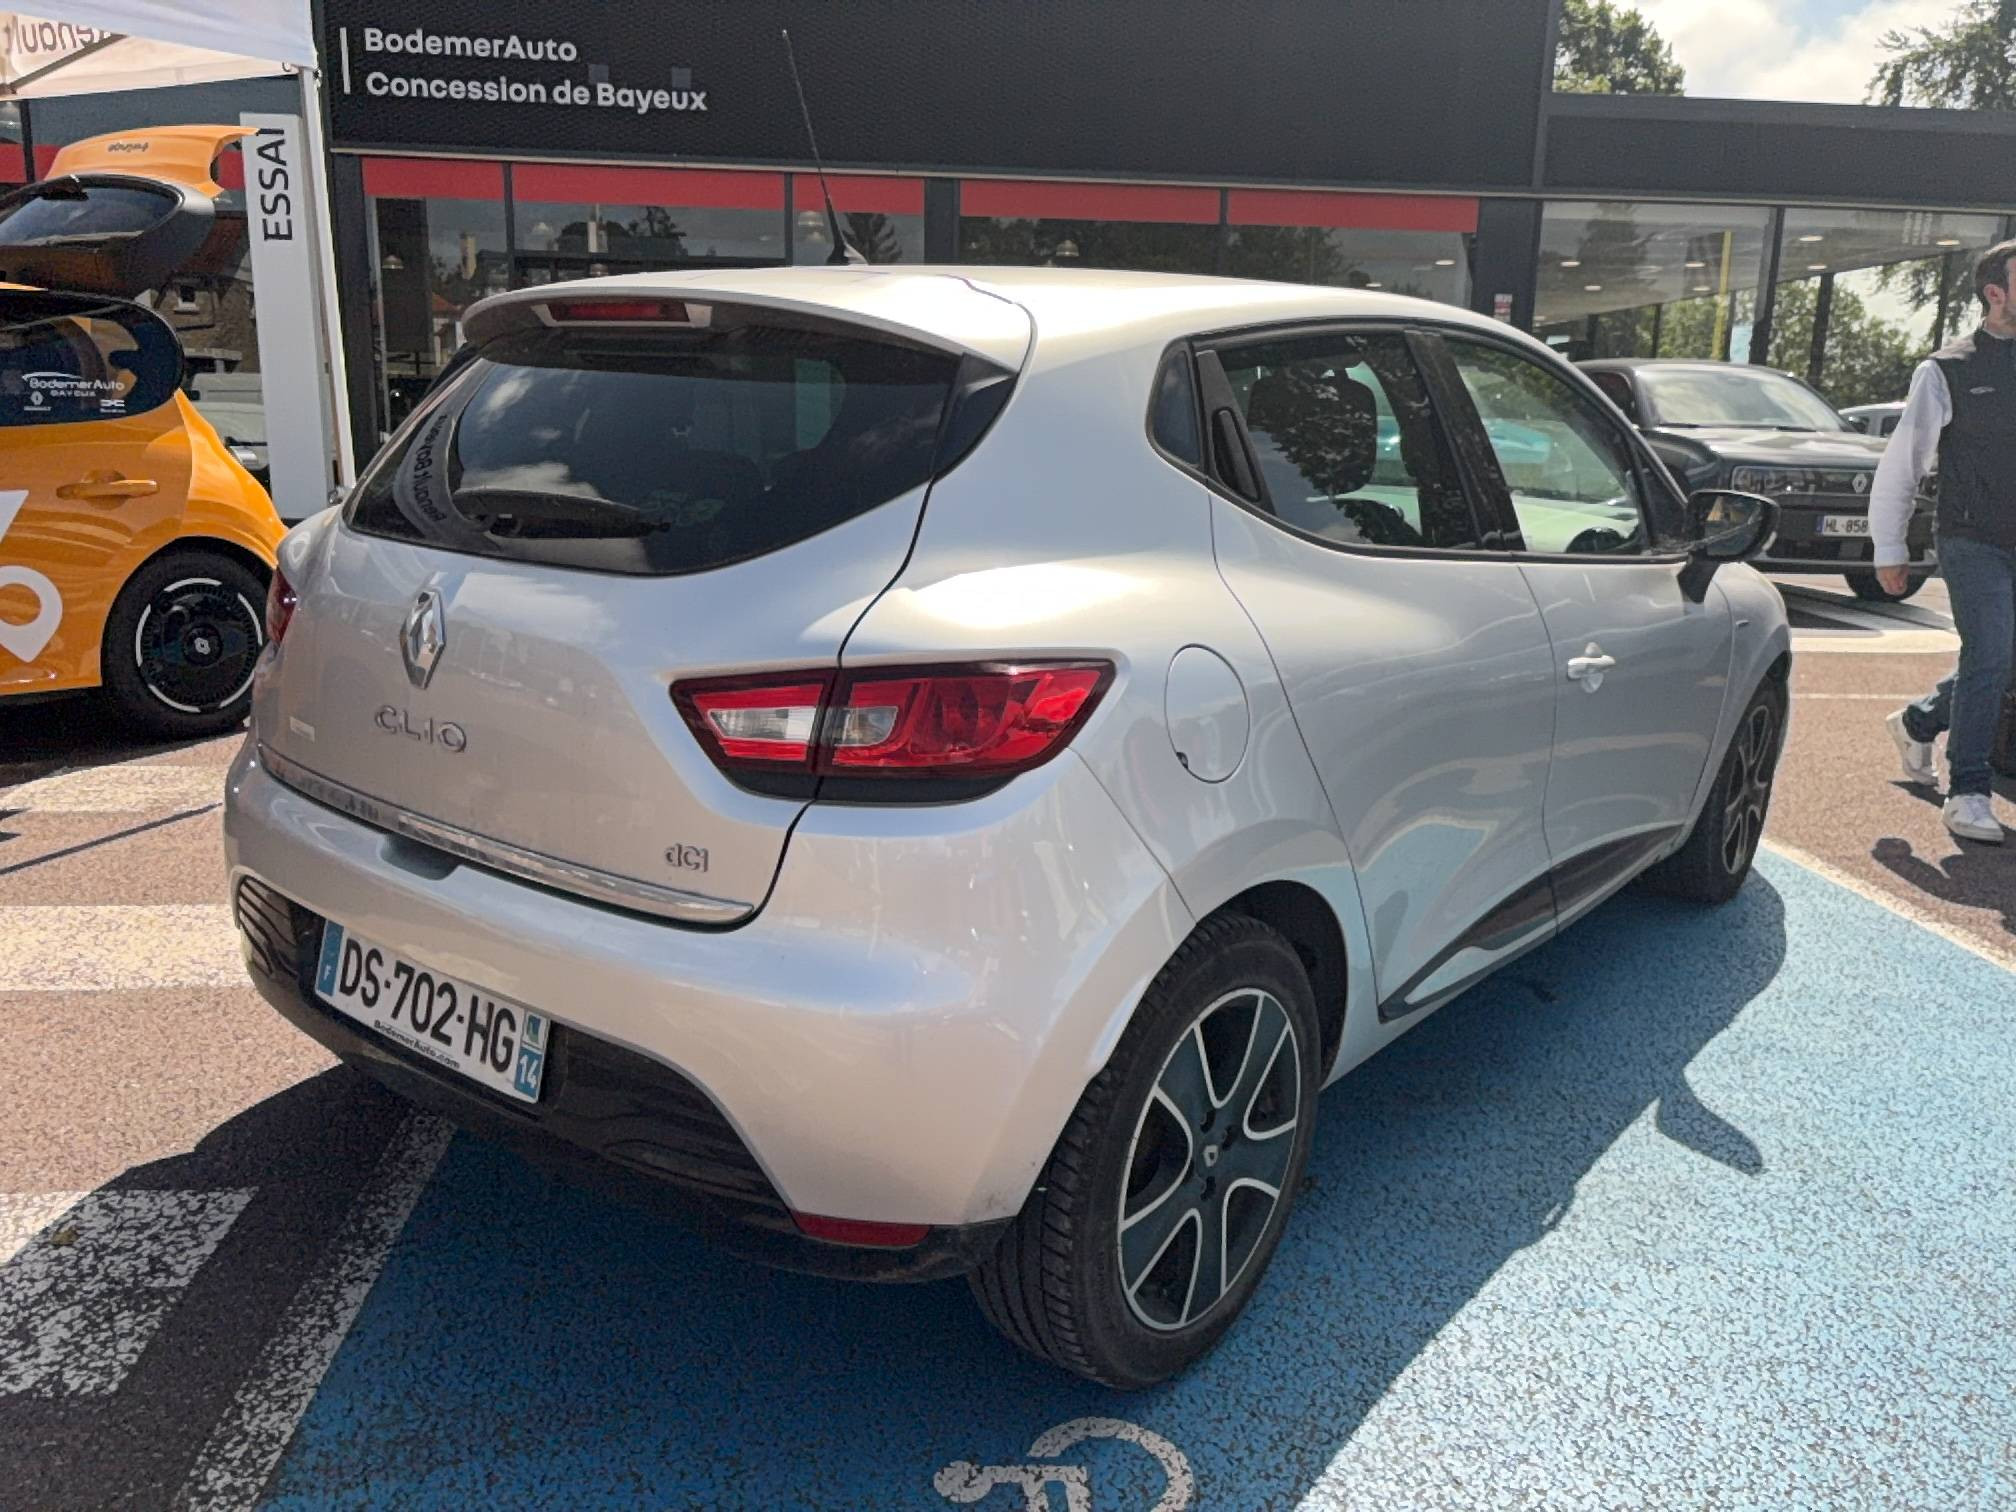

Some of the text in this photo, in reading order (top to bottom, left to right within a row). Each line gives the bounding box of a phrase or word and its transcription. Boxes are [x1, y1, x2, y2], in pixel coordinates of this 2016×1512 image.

[364, 28, 577, 62] BodemerAuto
[365, 72, 709, 114] Concession de Bayeux
[256, 127, 294, 242] ESSAI
[29, 378, 125, 391] BodemerAuto
[375, 704, 468, 753] CLIO
[324, 965, 332, 980] F
[338, 936, 517, 1074] DS-702-HG
[519, 1054, 539, 1089] 14
